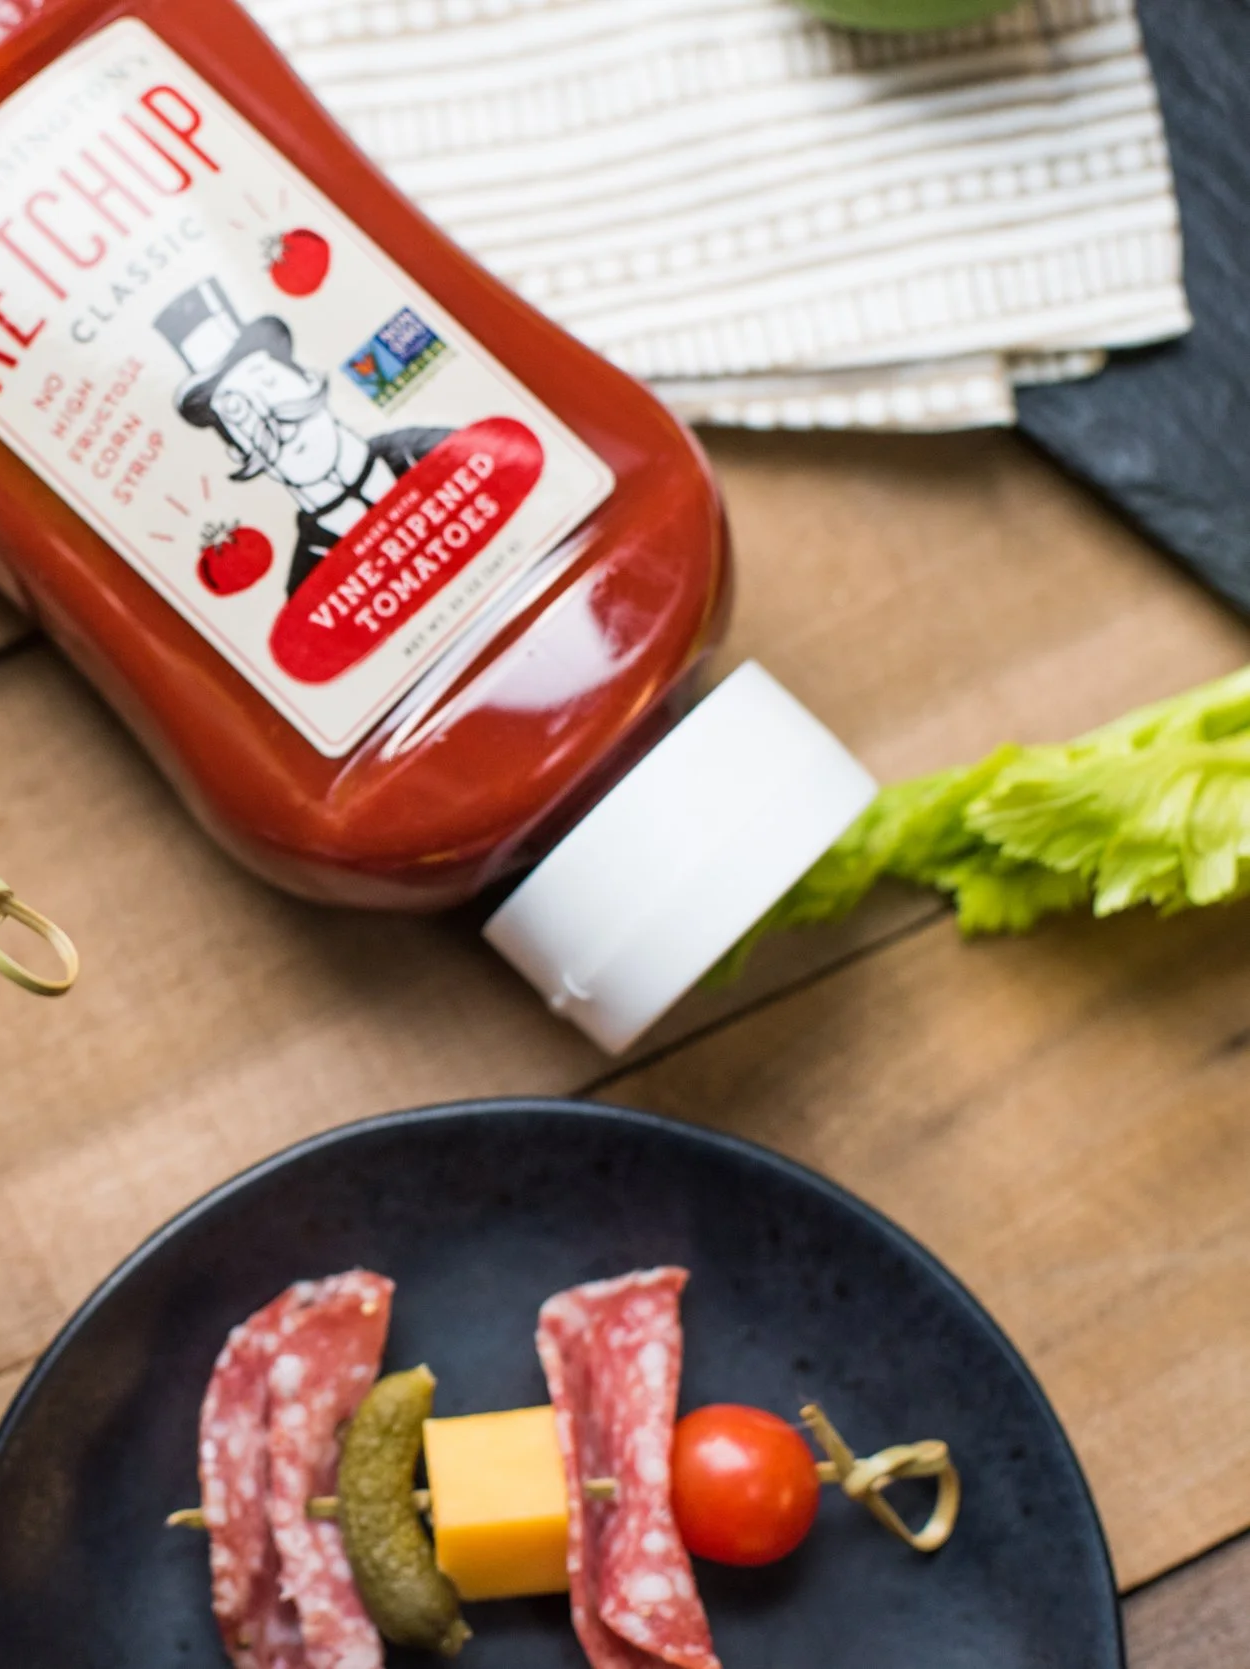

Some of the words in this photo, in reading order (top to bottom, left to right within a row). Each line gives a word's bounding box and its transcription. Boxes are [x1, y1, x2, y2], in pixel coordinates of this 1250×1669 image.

[69, 216, 204, 343] CLASSIC
[31, 374, 62, 410] NO
[49, 377, 94, 439] HIGH
[66, 356, 143, 463] FRUCTOSE
[90, 411, 143, 477] CORN
[111, 430, 164, 505] SYRUP
[307, 451, 495, 627] VINE-RIPENED
[352, 518, 390, 555] MADE
[353, 490, 497, 631] TOMATOES
